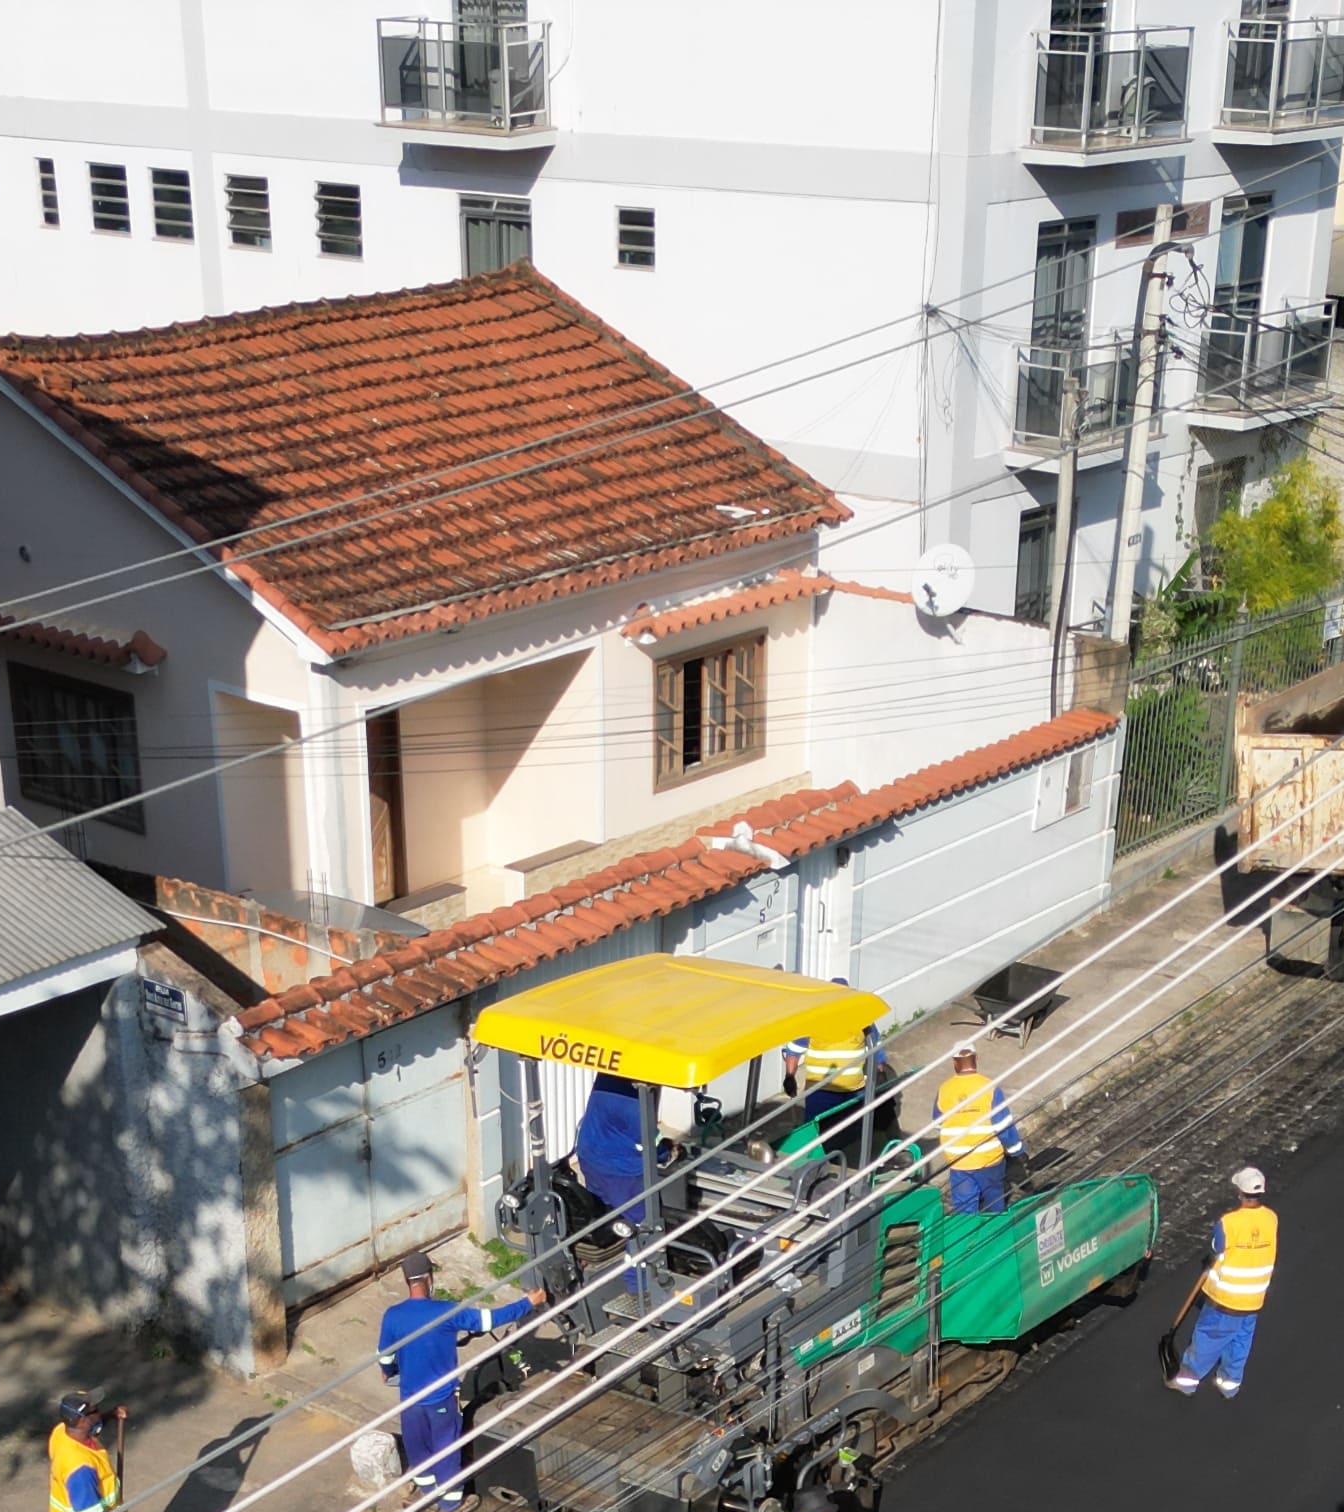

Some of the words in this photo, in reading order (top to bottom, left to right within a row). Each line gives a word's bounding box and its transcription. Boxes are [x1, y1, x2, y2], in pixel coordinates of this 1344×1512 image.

[759, 879, 781, 924] 502
[540, 1032, 622, 1072] VÖGELE
[1056, 1237, 1099, 1272] VÖGELE
